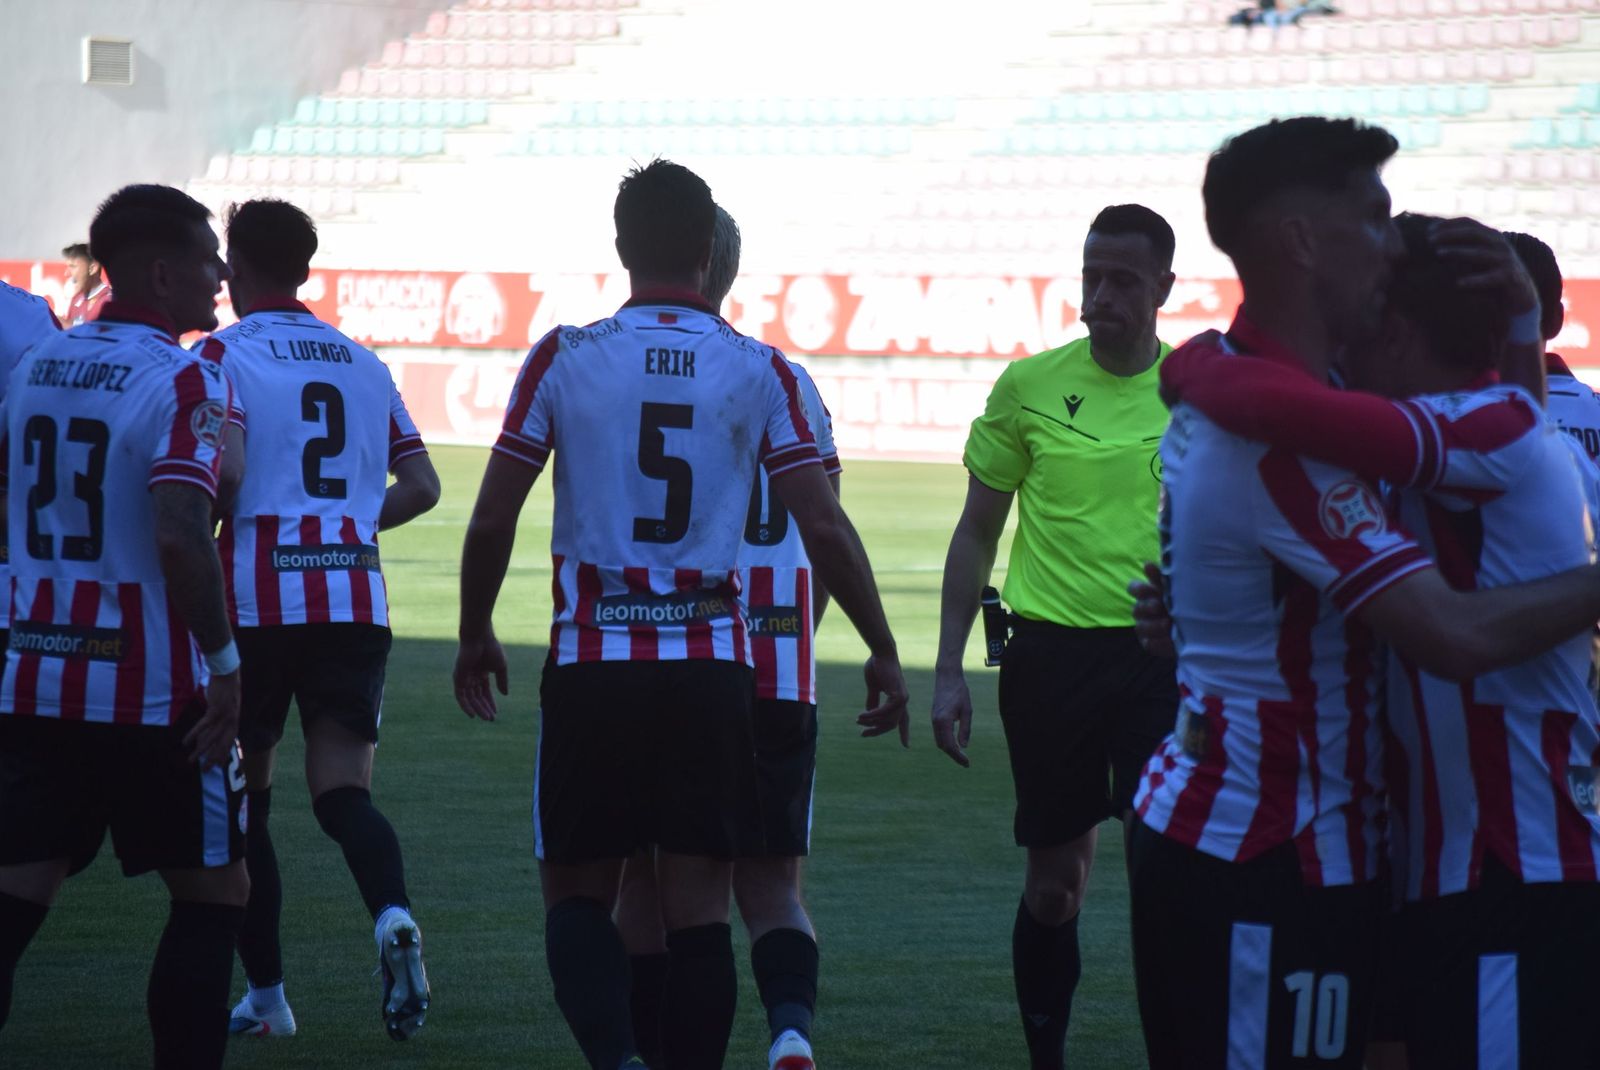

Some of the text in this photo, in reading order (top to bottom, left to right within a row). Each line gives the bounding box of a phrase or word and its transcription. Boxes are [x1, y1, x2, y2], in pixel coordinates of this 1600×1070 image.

[27, 358, 75, 387] SERGI
[269, 339, 353, 364] L. LUENGO
[645, 347, 695, 378] ERIK
[301, 381, 347, 500] 2
[24, 414, 110, 562] 23
[632, 401, 694, 545] 5
[595, 598, 728, 622] leomotor.net
[1282, 970, 1350, 1060] 10
